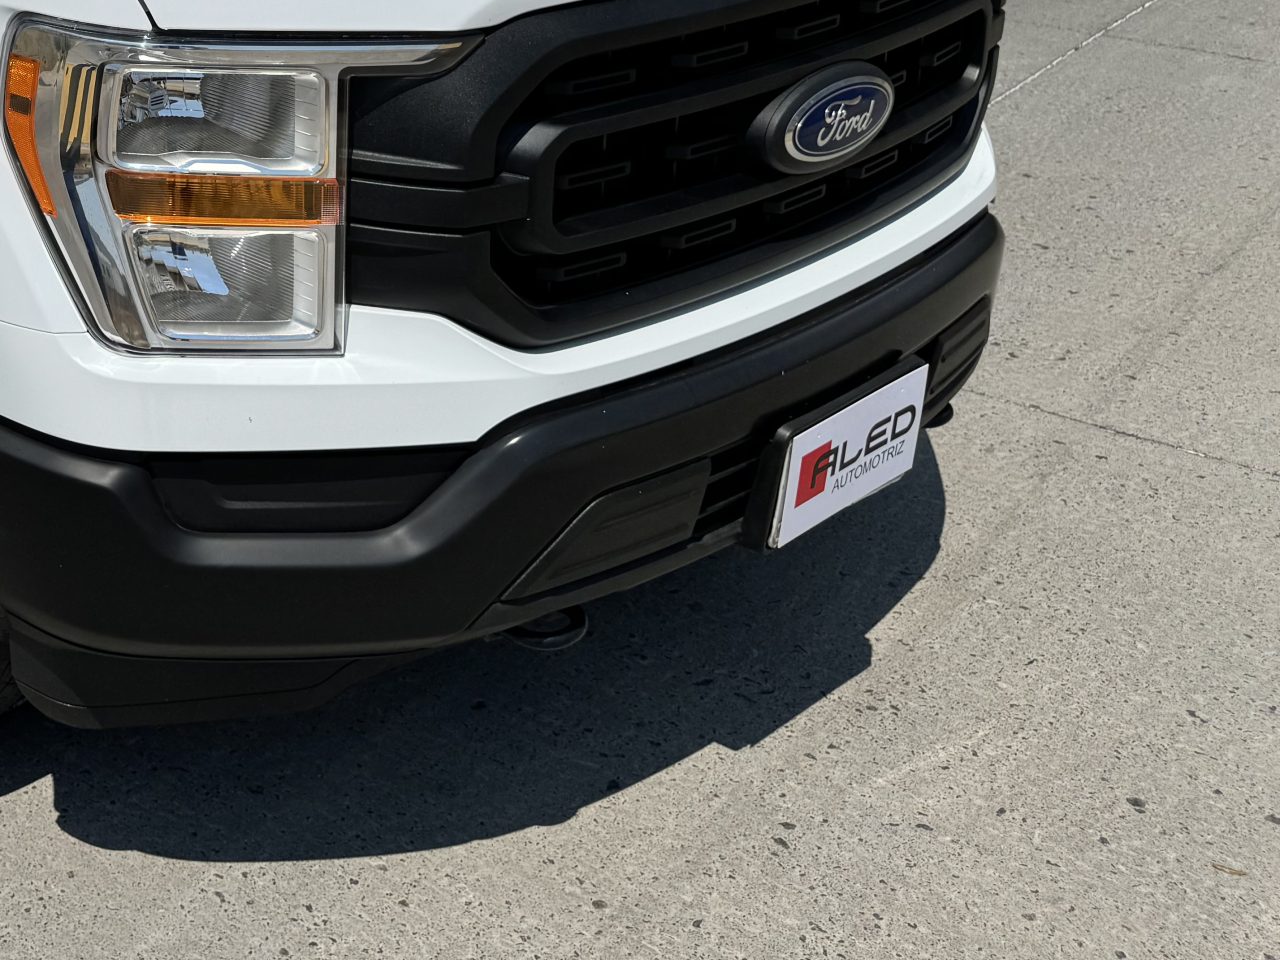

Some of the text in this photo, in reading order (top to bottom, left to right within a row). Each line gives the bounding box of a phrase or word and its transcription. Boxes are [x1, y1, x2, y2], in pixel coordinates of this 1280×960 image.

[816, 94, 875, 147] Ford
[809, 403, 917, 490] ALED
[830, 439, 906, 495] AUTOMOTRIZ
